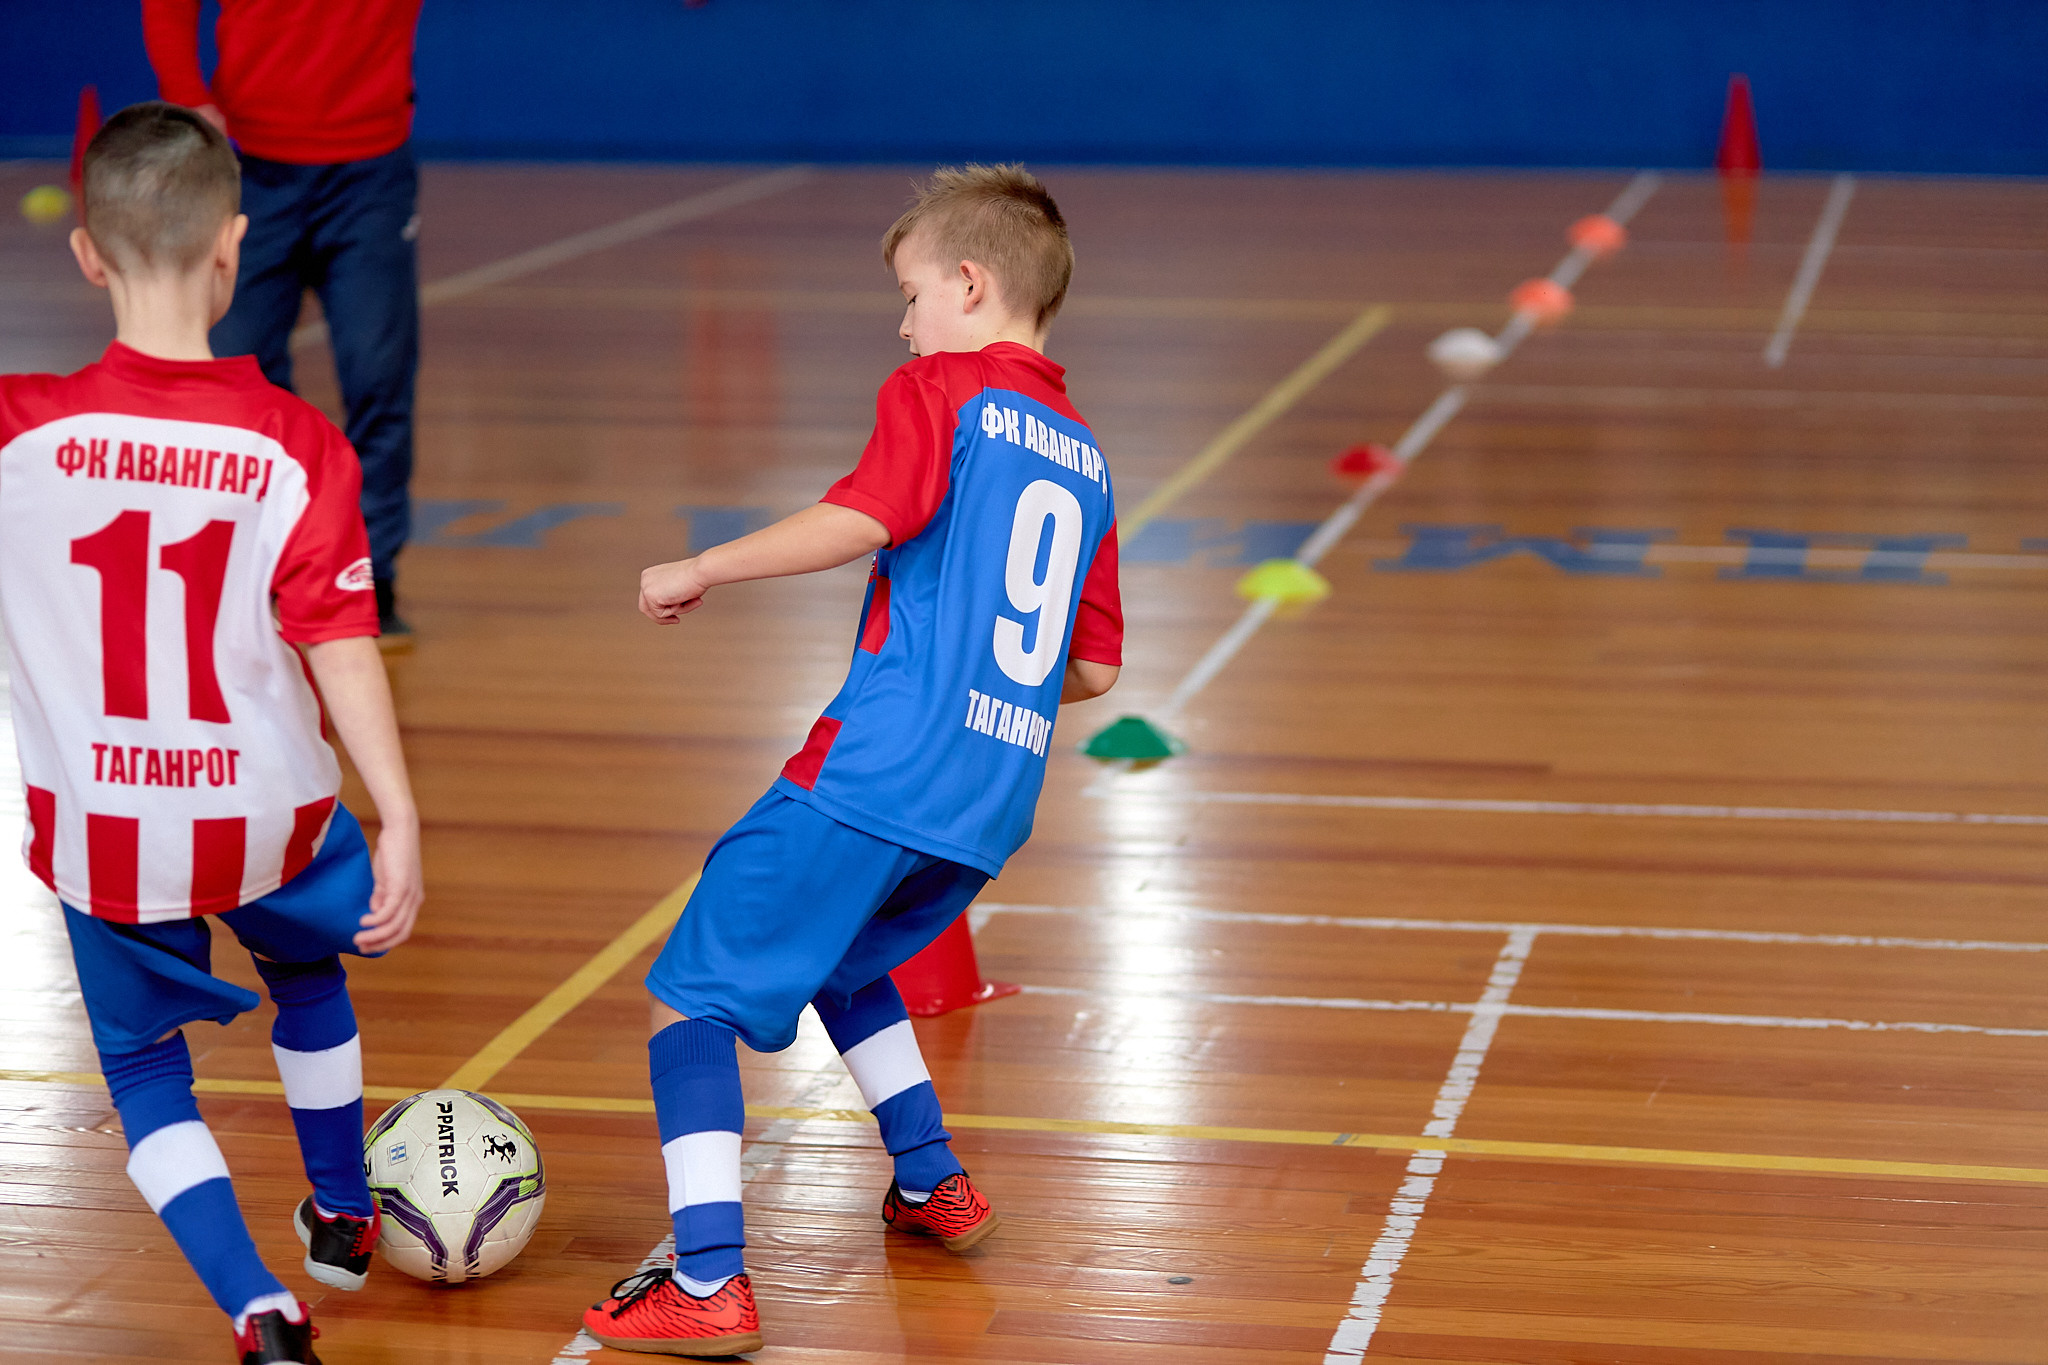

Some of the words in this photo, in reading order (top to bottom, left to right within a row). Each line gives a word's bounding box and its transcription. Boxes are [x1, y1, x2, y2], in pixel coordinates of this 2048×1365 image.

[982, 402, 1021, 446] ФК
[56, 437, 109, 479] ФК
[992, 479, 1083, 687] 9
[70, 508, 236, 724] 11
[91, 742, 241, 788] ТАГАНРОГ
[437, 1114, 460, 1198] PATRICK
